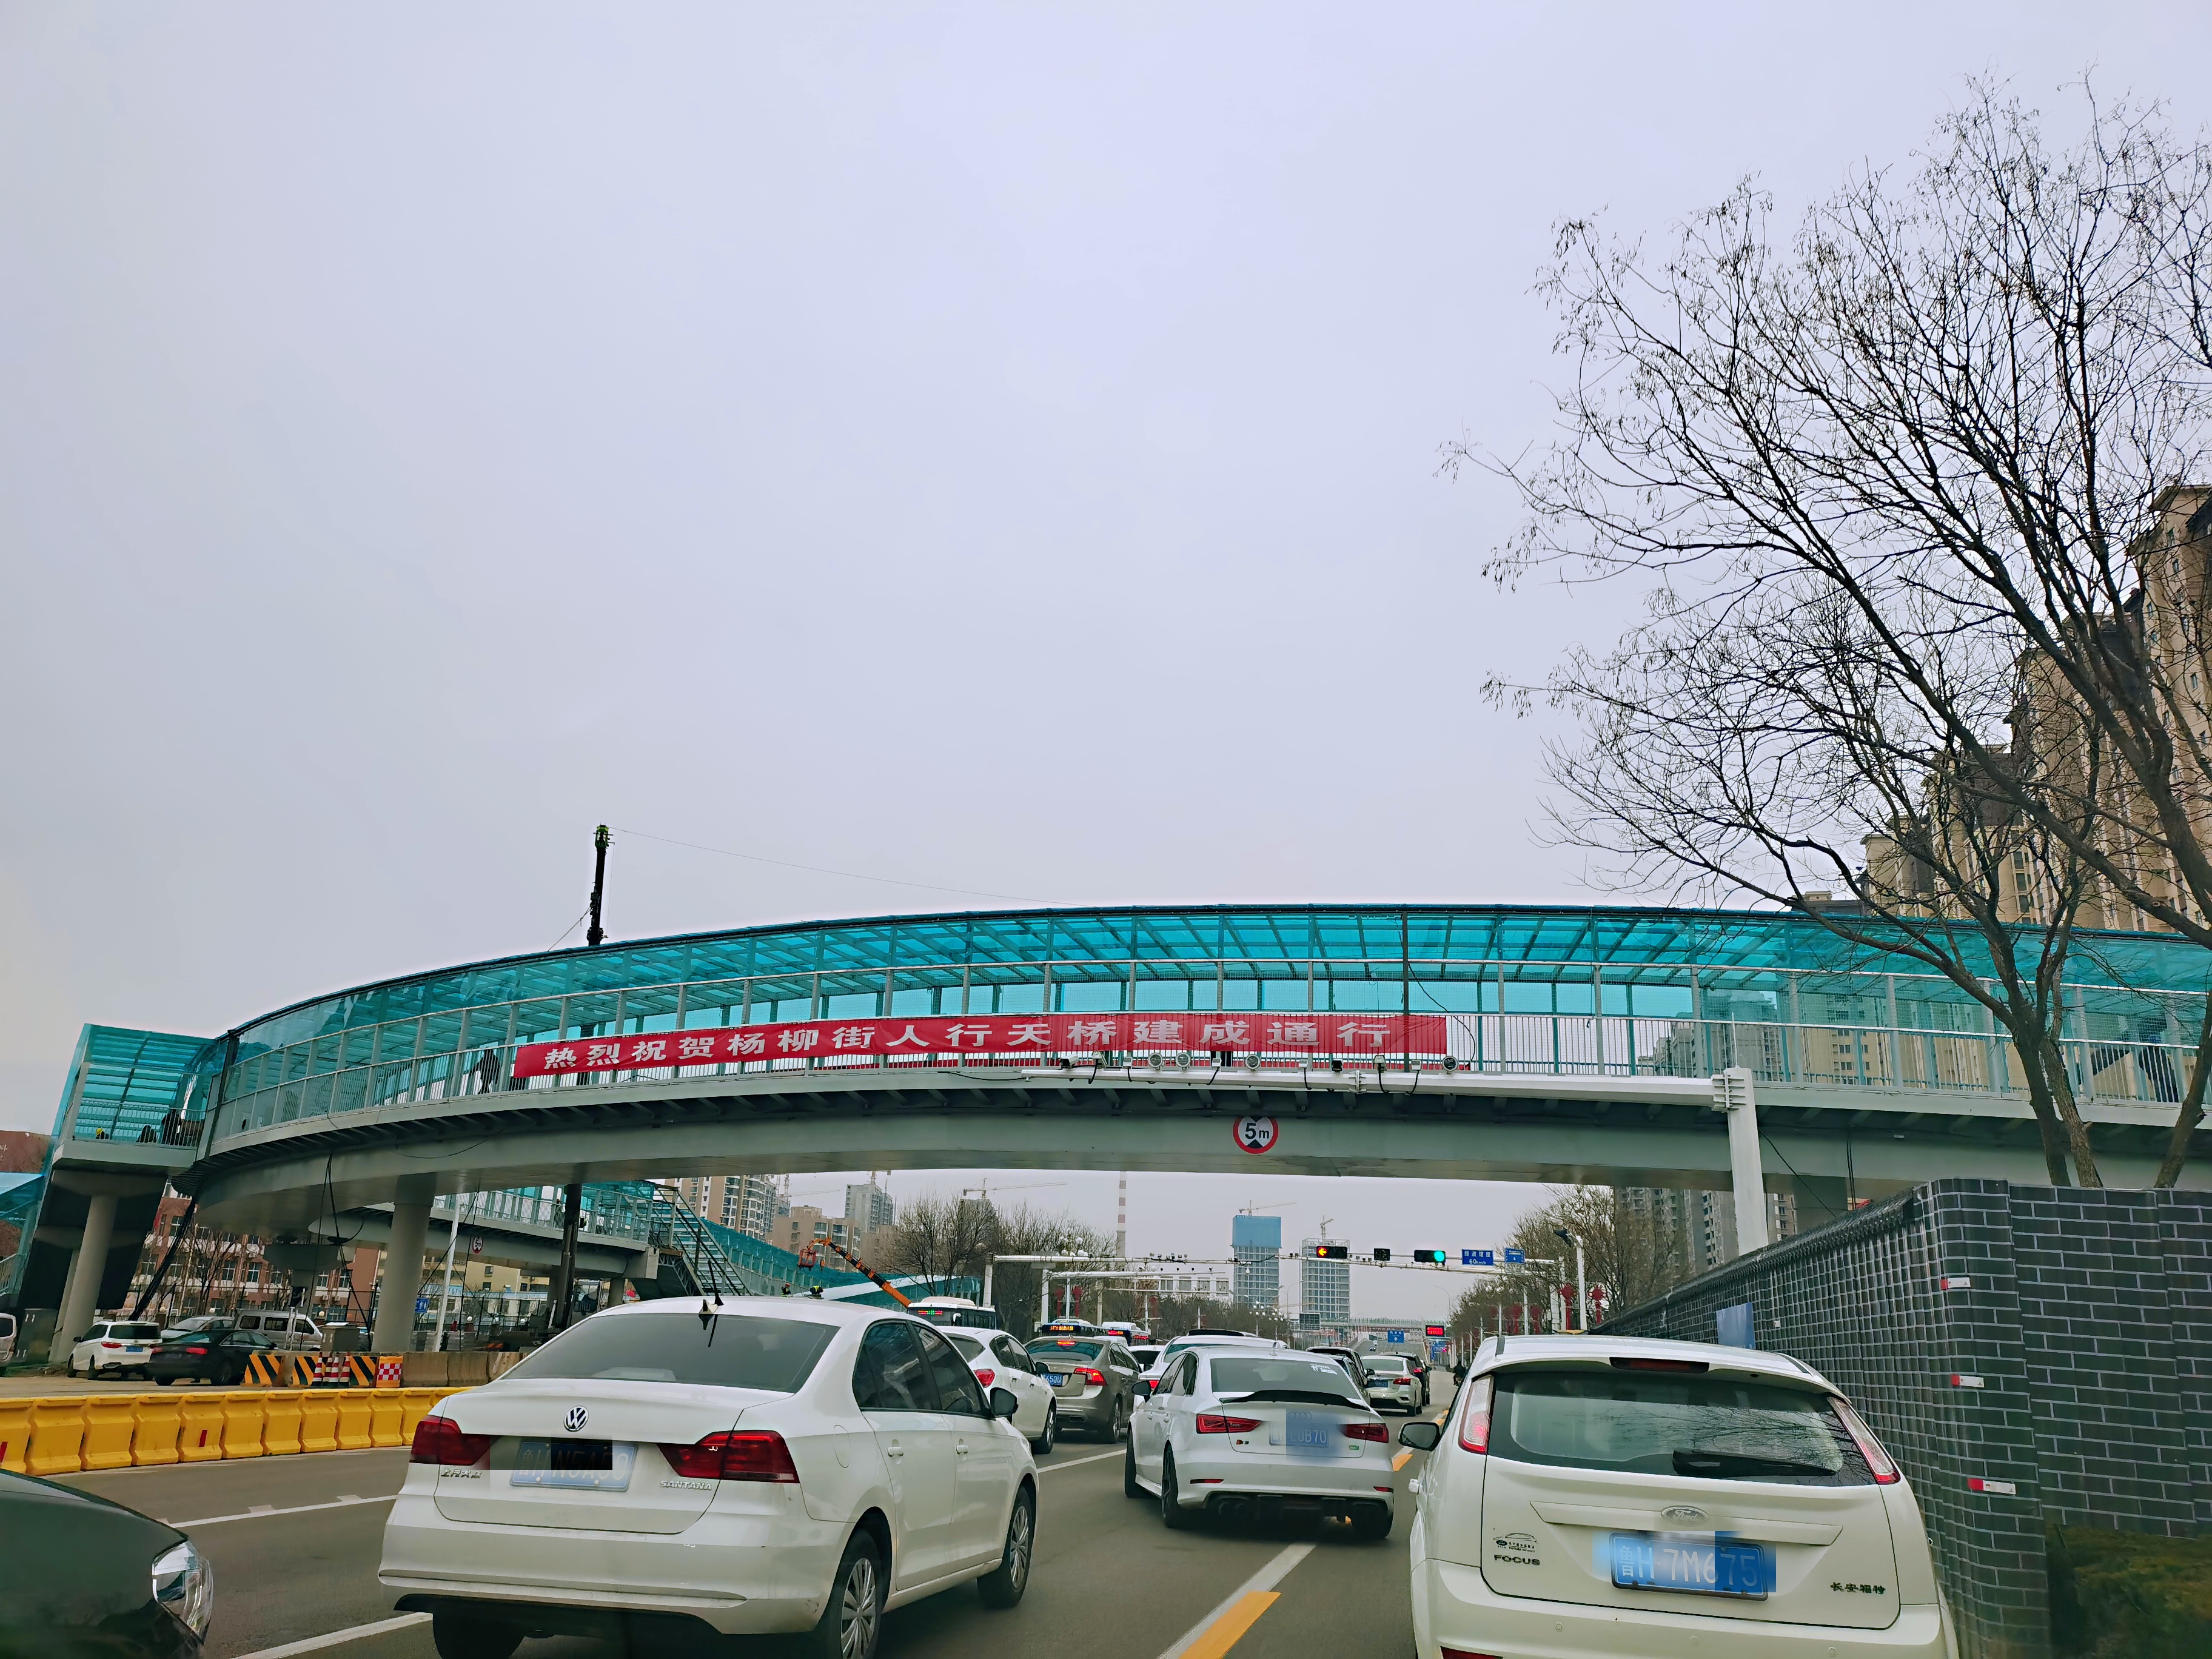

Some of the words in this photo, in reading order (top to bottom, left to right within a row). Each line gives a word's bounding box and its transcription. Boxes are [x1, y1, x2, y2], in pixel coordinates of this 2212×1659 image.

[544, 1020, 1391, 1070] 热烈祝贺杨柳街人行天桥建成通行
[1245, 1123, 1270, 1139] 5m
[660, 1480, 712, 1490] SANTANA
[1672, 1509, 1698, 1521] Ford
[1494, 1555, 1540, 1565] FOCUS
[1830, 1582, 1885, 1595] 长安福特
